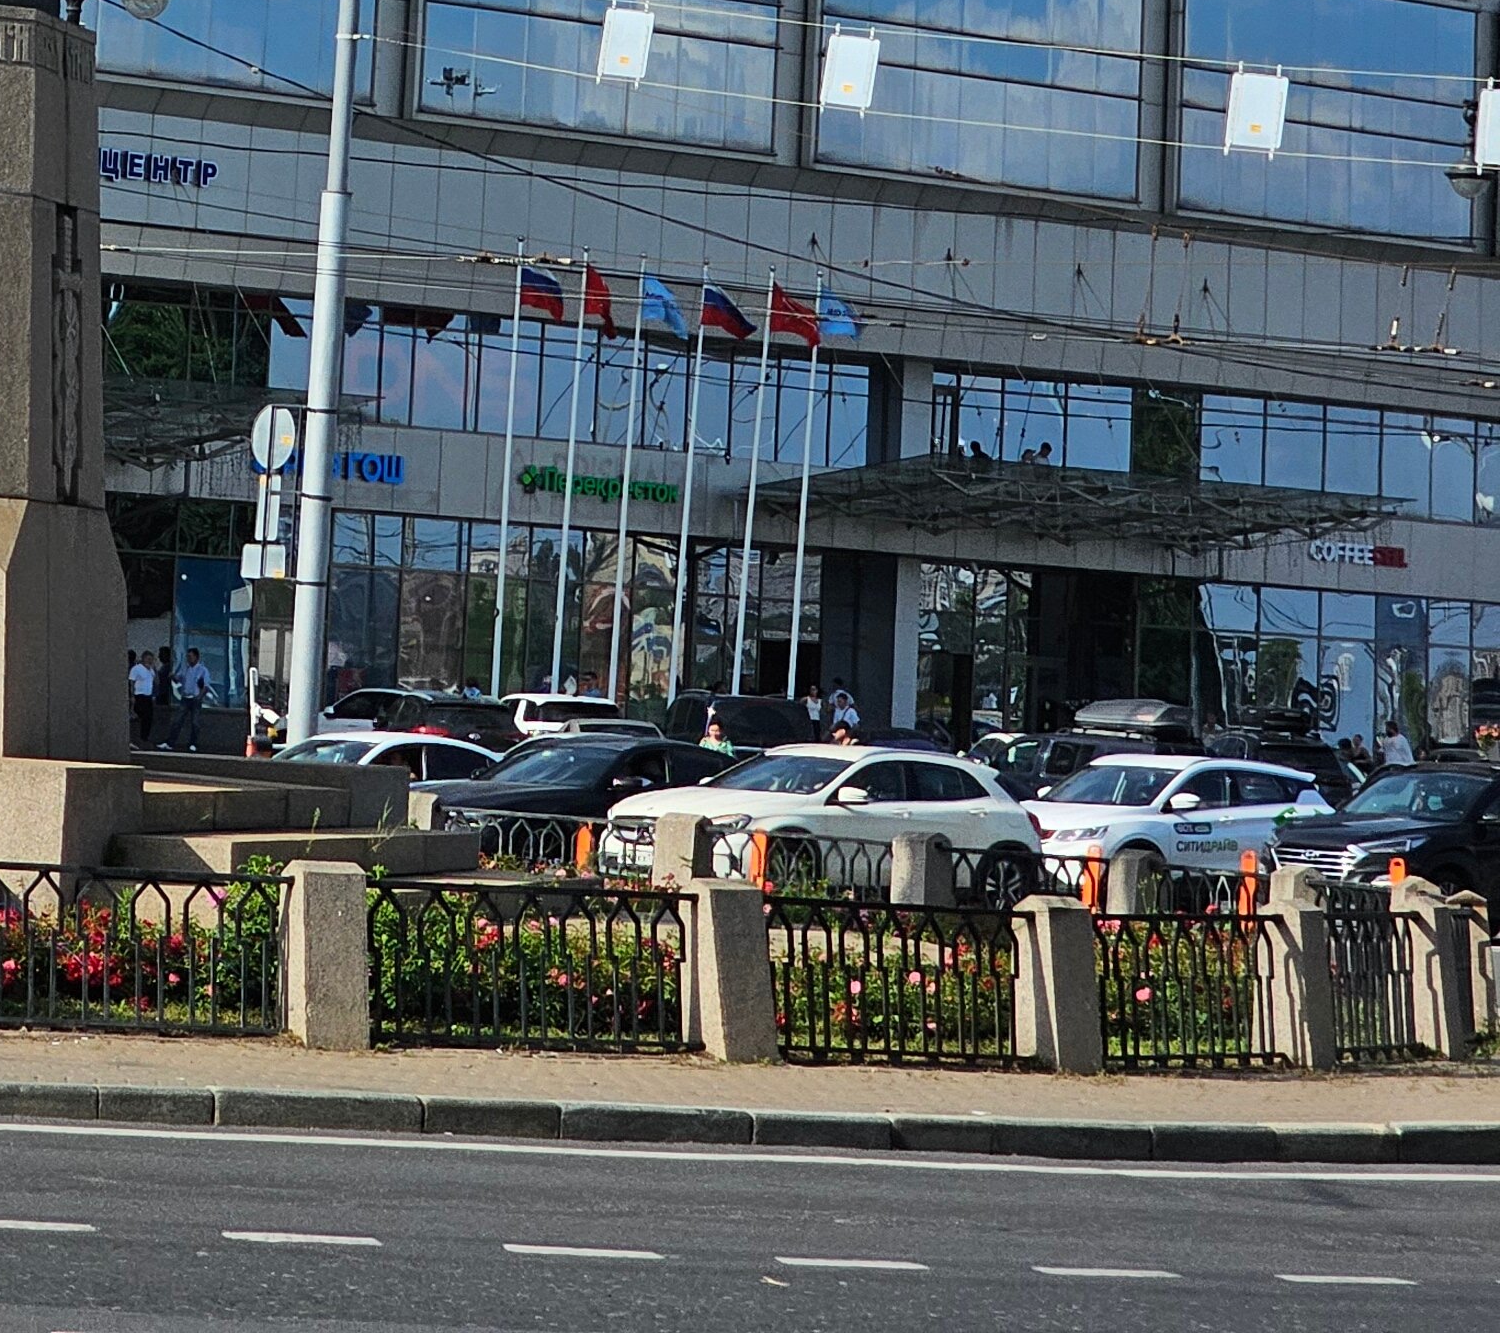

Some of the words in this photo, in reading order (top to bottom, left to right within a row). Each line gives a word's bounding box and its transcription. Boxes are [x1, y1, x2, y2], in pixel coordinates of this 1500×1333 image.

[100, 148, 218, 187] ЦЕНТР
[348, 452, 405, 484] ГОШ
[543, 466, 679, 503] Перекрсток
[1310, 539, 1374, 565] COFFEE
[1176, 837, 1239, 853] СИТИДРАЙВ
